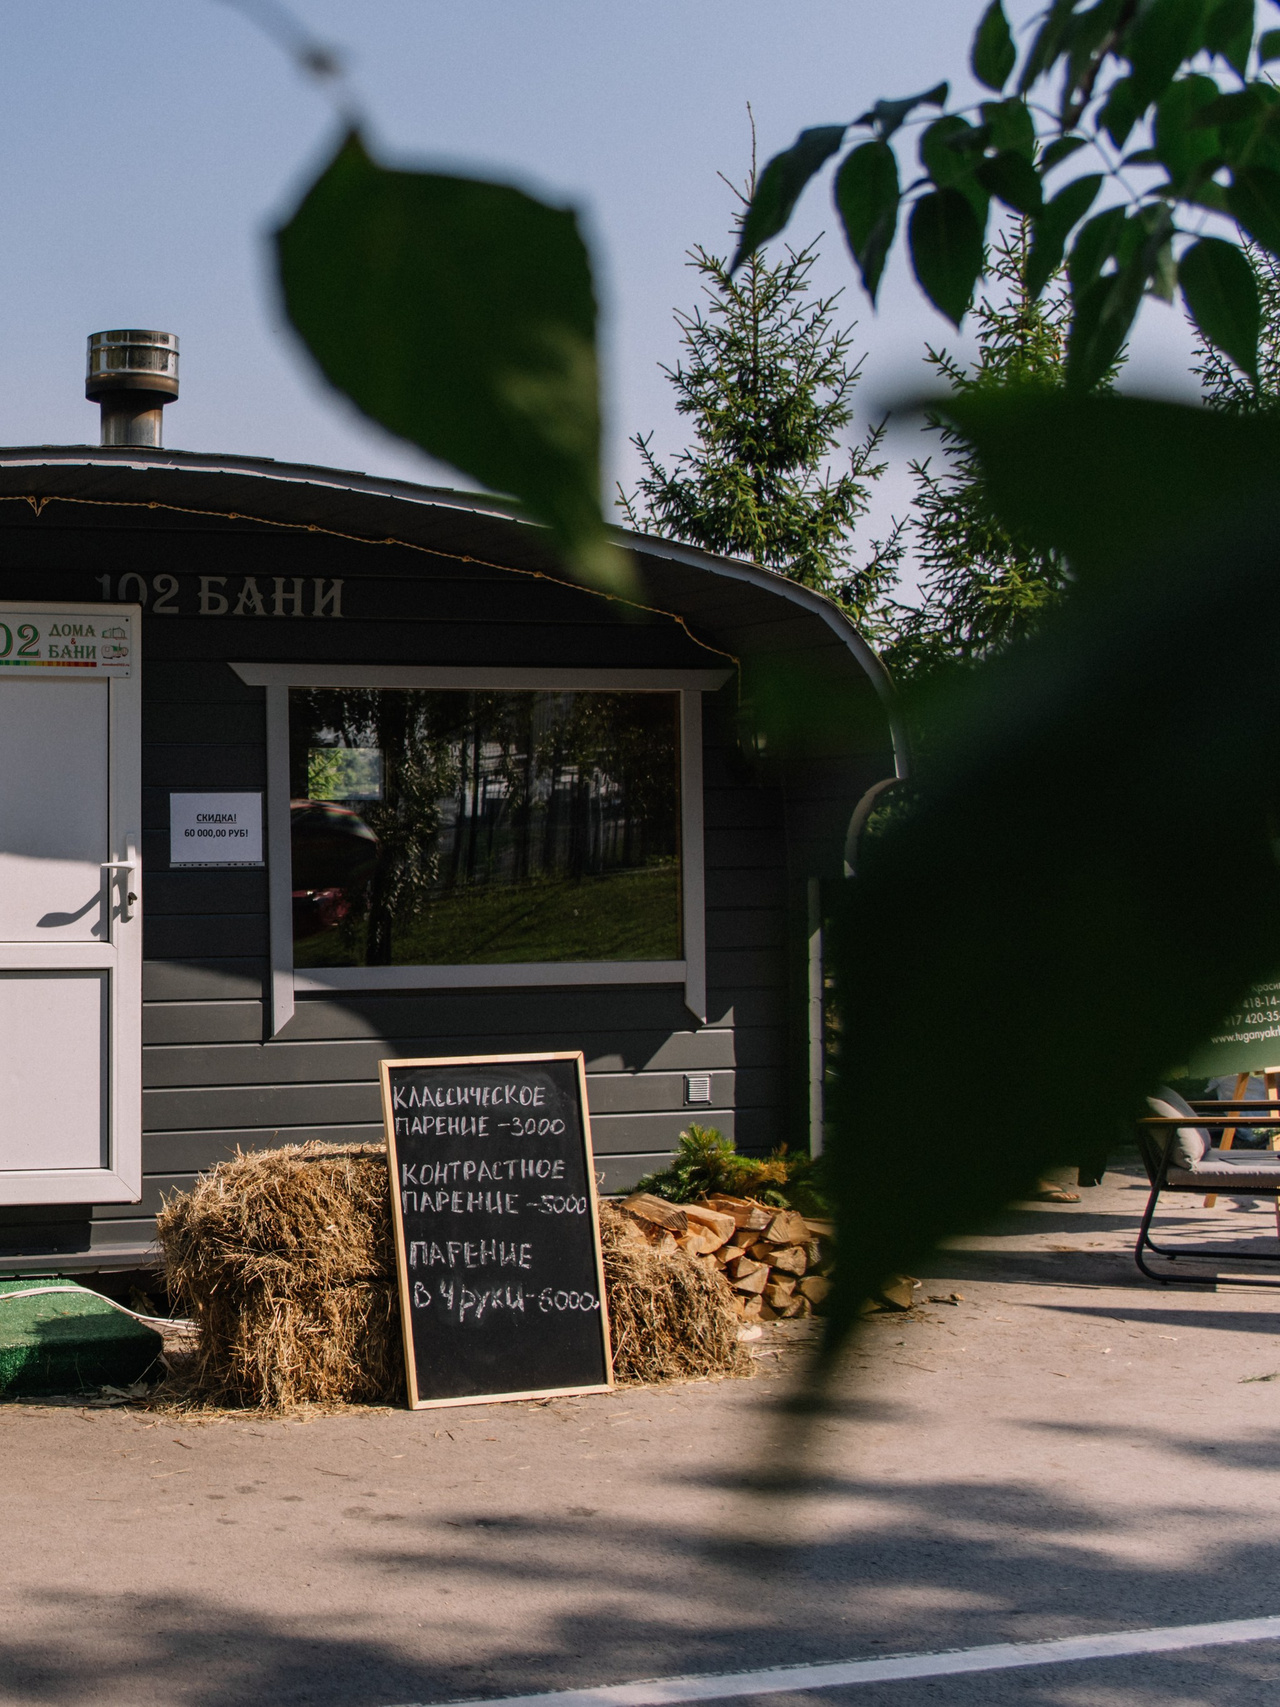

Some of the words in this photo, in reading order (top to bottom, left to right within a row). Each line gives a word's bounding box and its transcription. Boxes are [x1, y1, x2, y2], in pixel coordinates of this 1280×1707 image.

[94, 572, 180, 614] 102
[197, 575, 345, 618] БАНИ
[48, 624, 96, 638] ДОМА
[48, 645, 97, 660] БАНИ
[196, 813, 237, 824] СКИДКА!
[184, 829, 195, 838] 60
[197, 829, 226, 839] 000,00
[228, 829, 249, 838] РУБ!
[393, 1085, 546, 1110] КЛАССИЧЕСКОЕ
[395, 1115, 489, 1136] ПАРЕНИЕ
[402, 1158, 566, 1186] КОНТРАСТНОЕ
[402, 1191, 519, 1214] ПАРЕНИЕ
[409, 1239, 533, 1269] ПАРЕНИЕ
[414, 1281, 432, 1308] В
